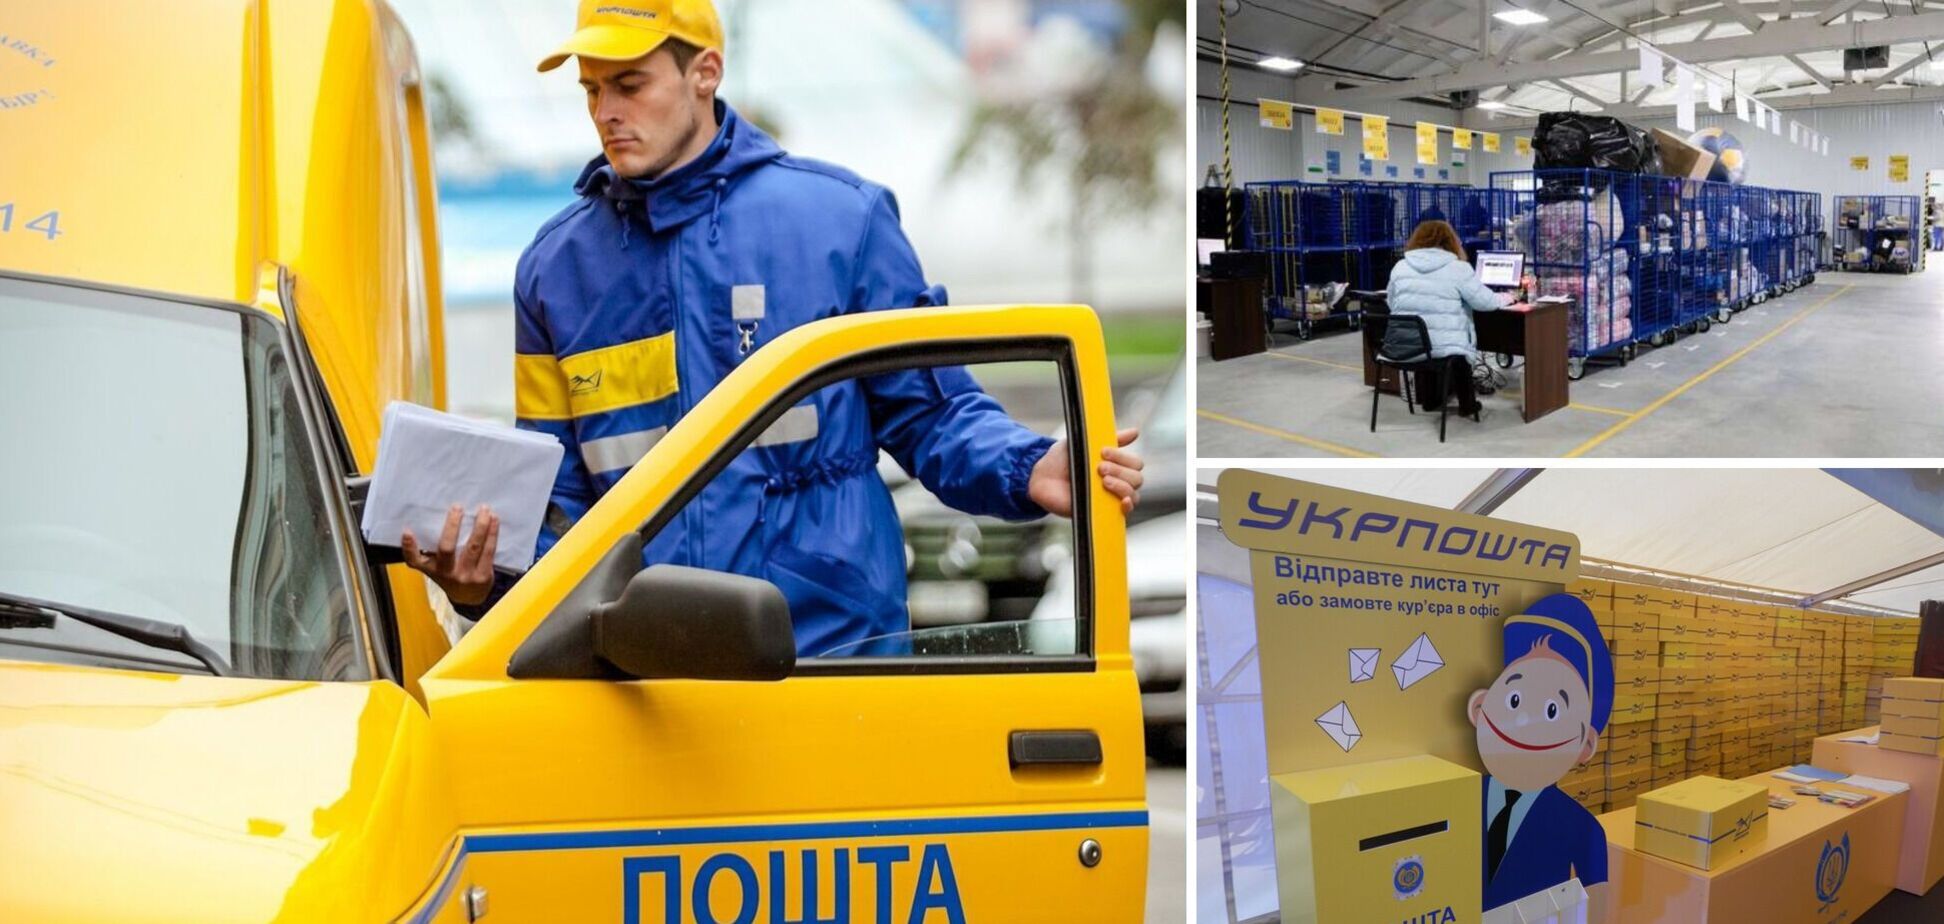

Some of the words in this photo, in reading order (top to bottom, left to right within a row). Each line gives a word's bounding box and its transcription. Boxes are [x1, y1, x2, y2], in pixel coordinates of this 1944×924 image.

[1239, 491, 1571, 570] УКРПОШТА
[1274, 556, 1404, 587] Відправте
[1410, 575, 1466, 593] листа
[1472, 581, 1500, 599] тут
[1276, 590, 1314, 607] або
[1320, 596, 1393, 611] замовте
[1398, 599, 1453, 616] кур'єра
[1457, 604, 1466, 615] в
[1469, 603, 1500, 619] офіс
[622, 843, 967, 924] ПОШТА
